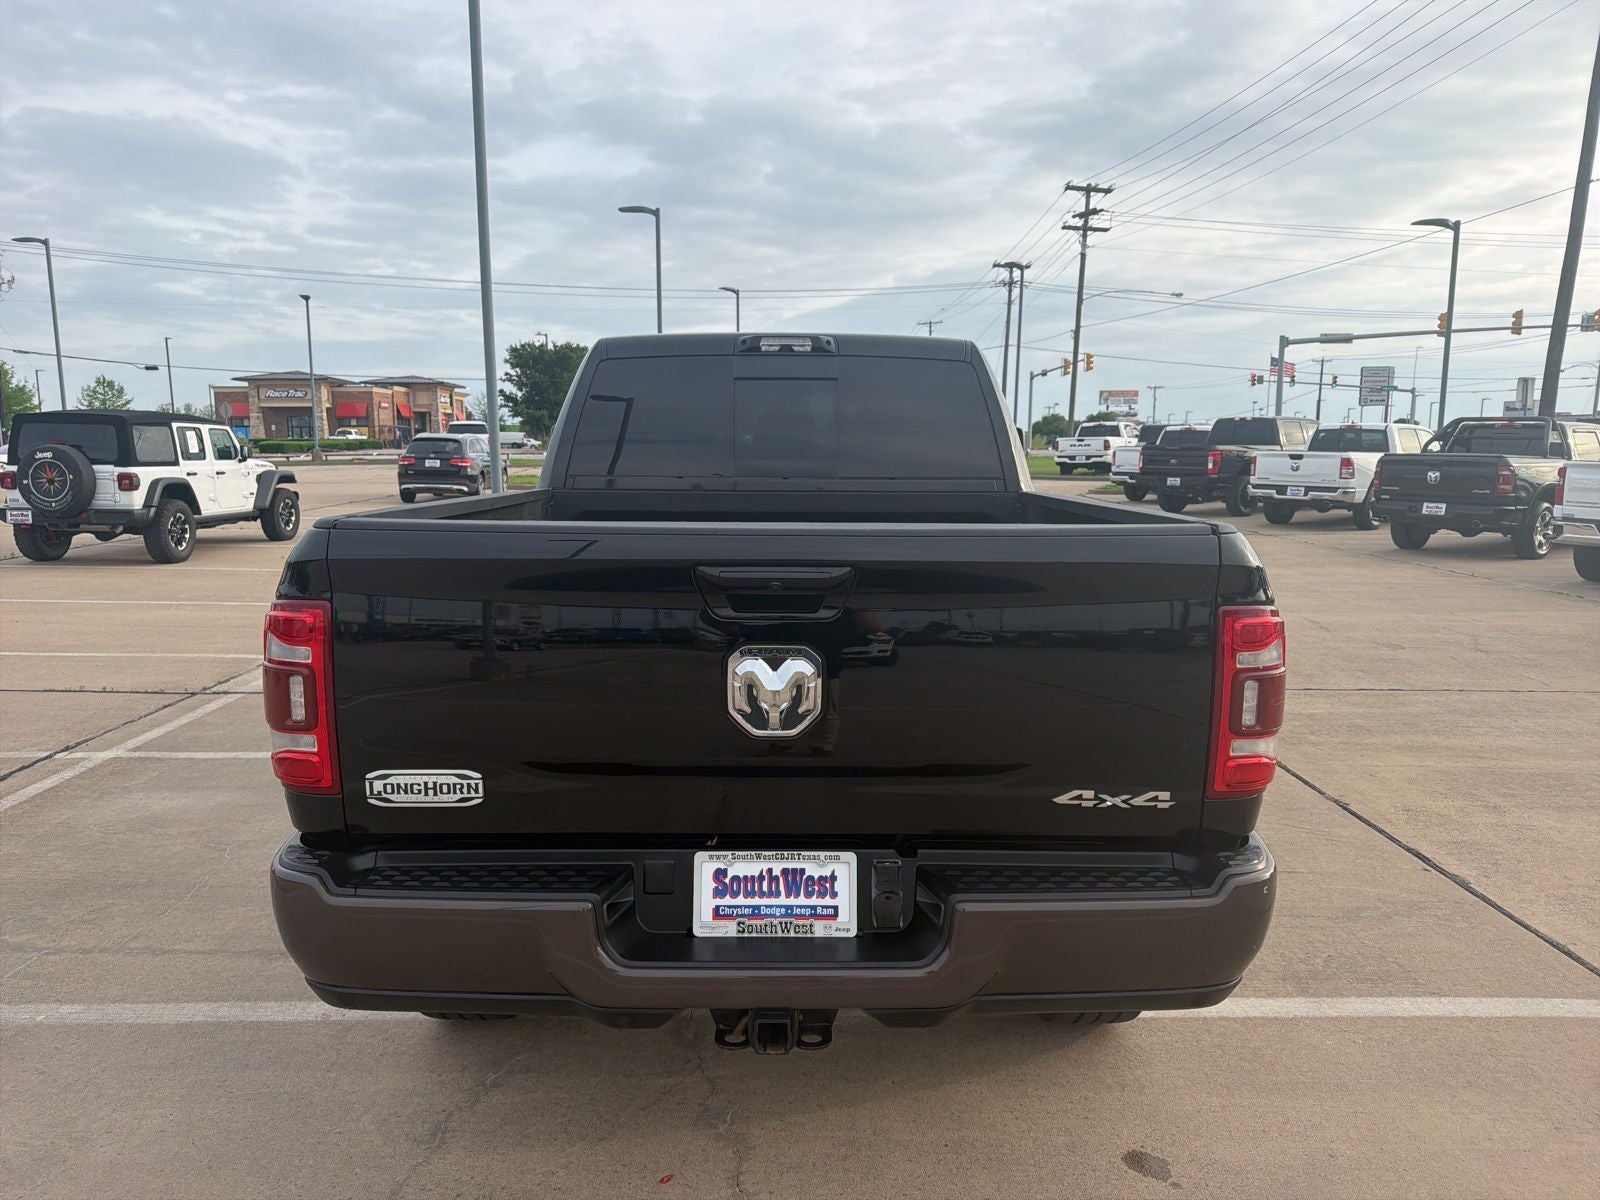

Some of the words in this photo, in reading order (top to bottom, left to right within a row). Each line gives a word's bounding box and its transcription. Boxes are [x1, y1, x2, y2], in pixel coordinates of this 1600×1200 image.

[266, 389, 307, 398] RaceTrac
[34, 451, 53, 459] Jeep
[1052, 789, 1176, 808] 4x4
[708, 852, 841, 861] www.SouthWestCDJRTexas.com
[712, 867, 839, 899] SouthWest
[719, 906, 753, 916] Chrysler
[760, 906, 786, 916] Dodge
[792, 906, 811, 917] Jeep
[816, 906, 835, 916] Ram
[736, 921, 816, 935] SouthWest
[834, 926, 851, 934] Jeep
